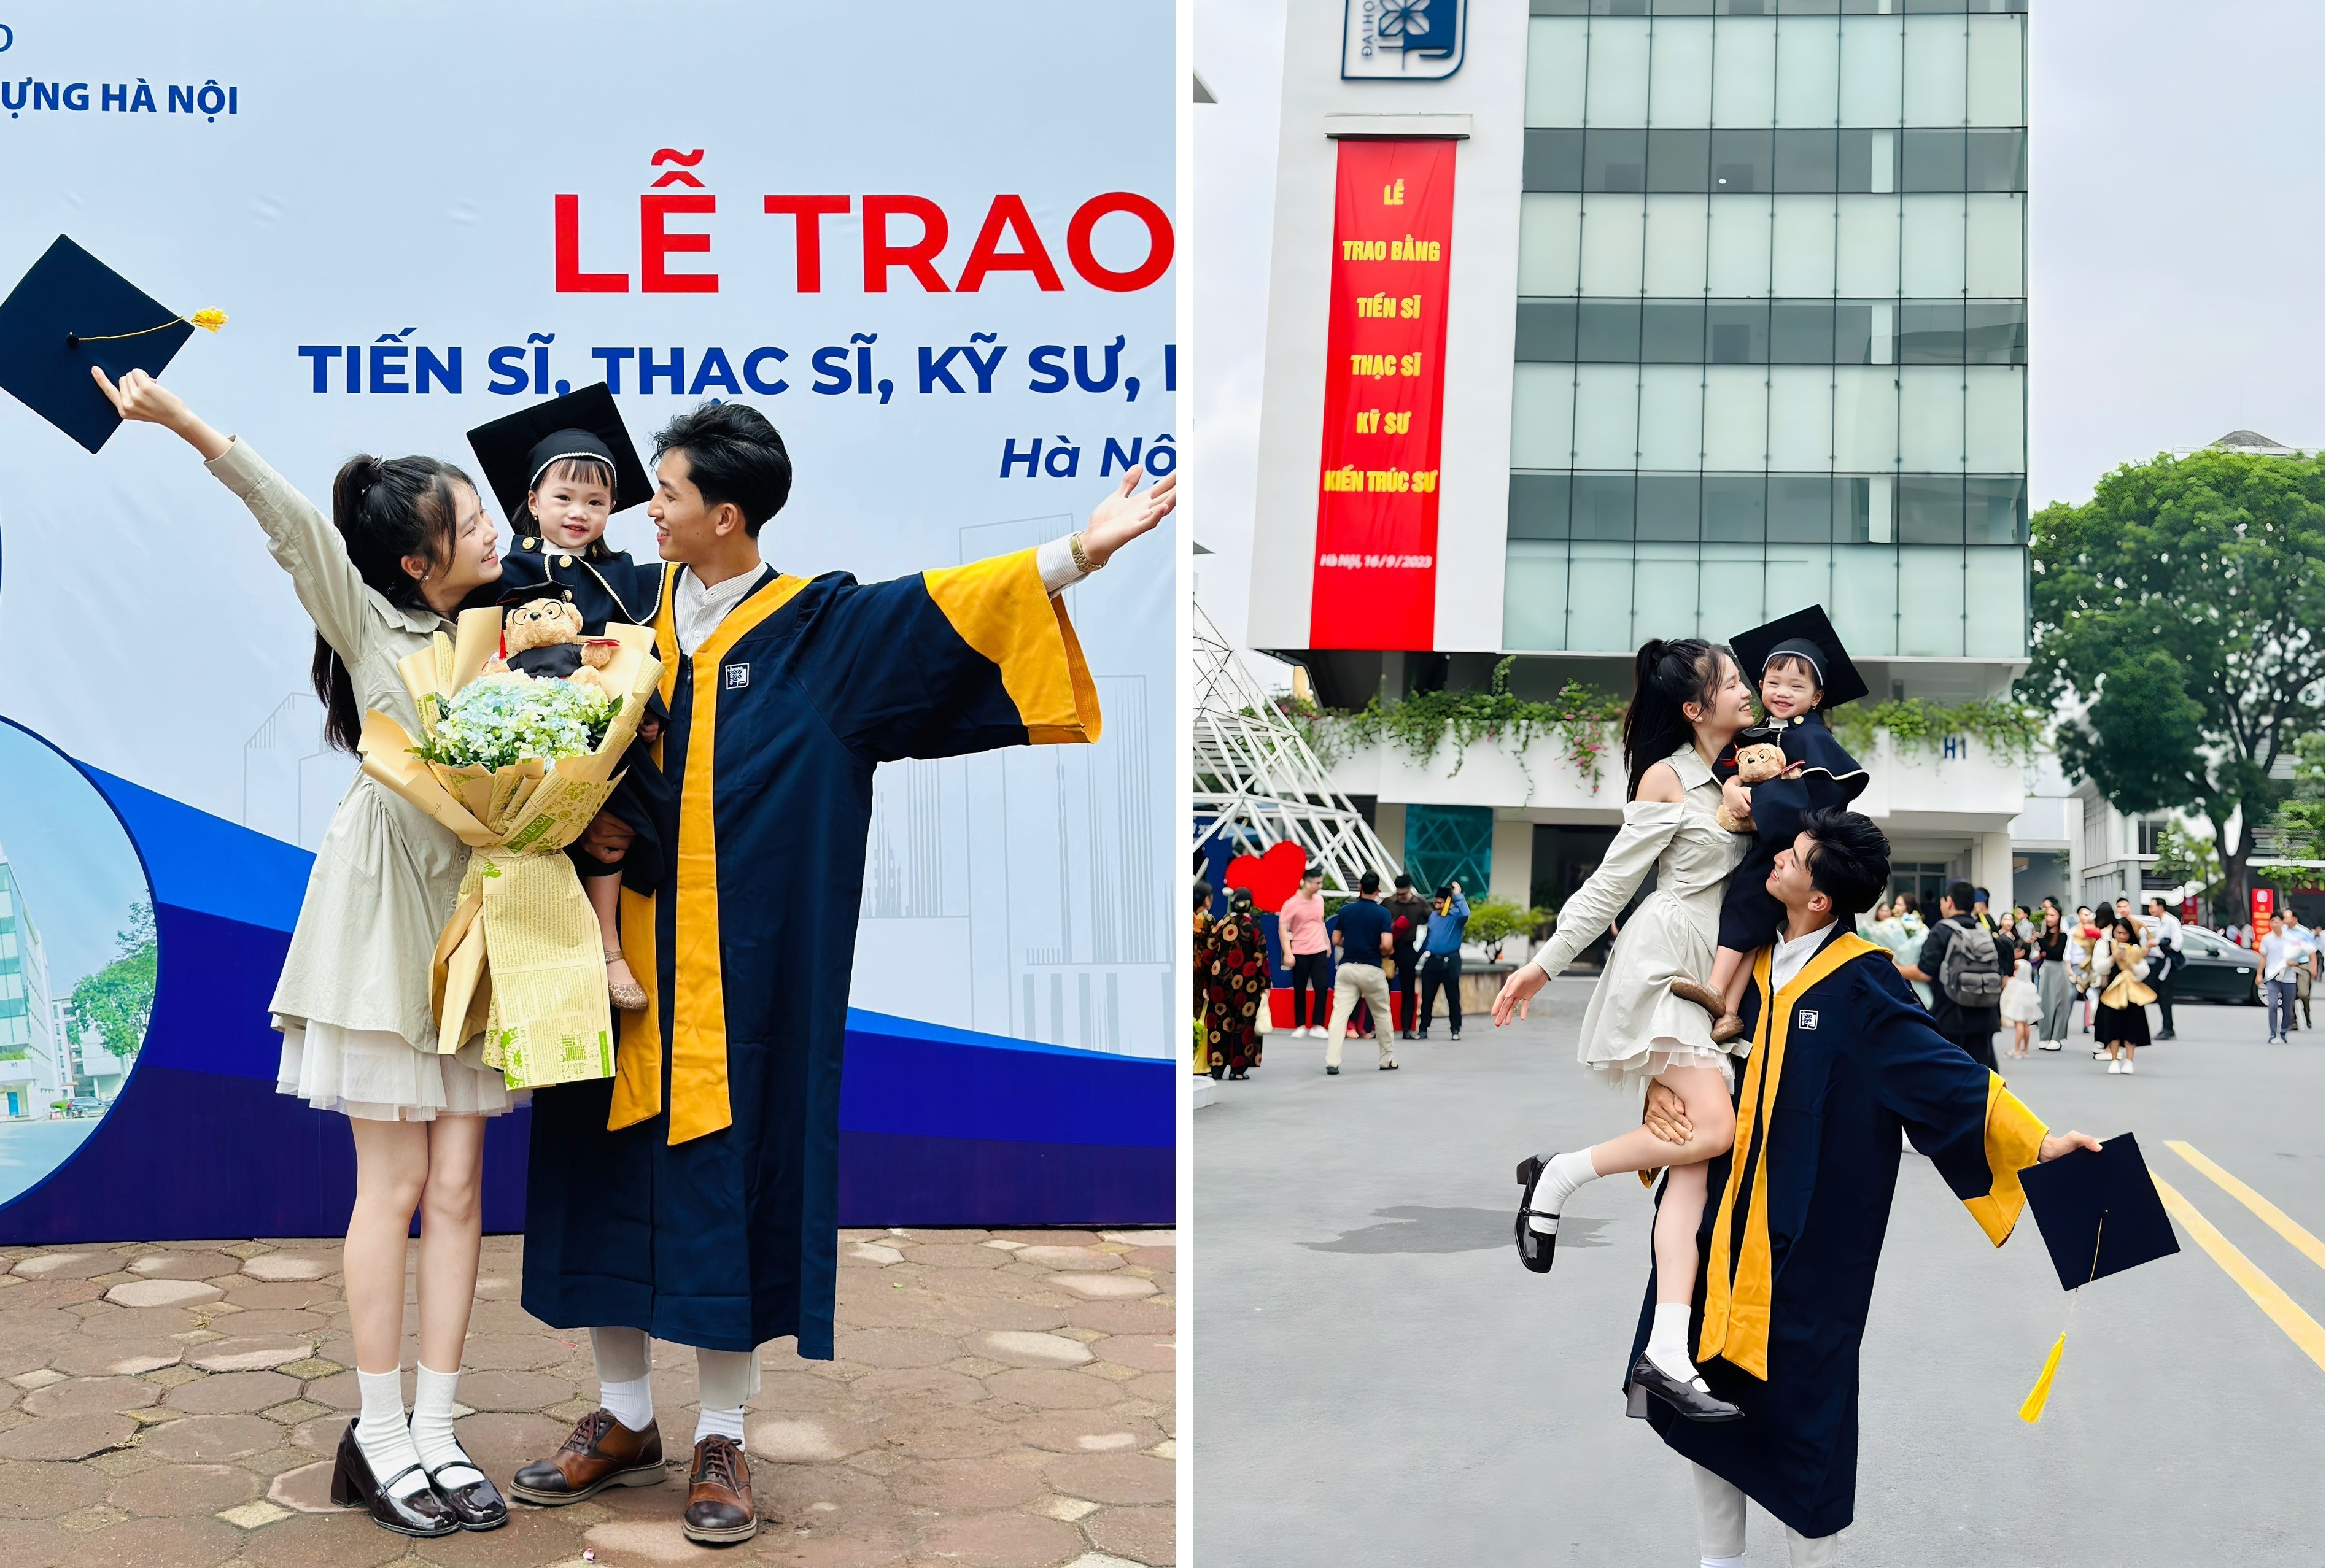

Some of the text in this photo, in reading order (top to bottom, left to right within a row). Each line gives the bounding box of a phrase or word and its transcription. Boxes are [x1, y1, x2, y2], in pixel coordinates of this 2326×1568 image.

[101, 77, 157, 113] HÀ
[168, 79, 238, 123] NỘI
[554, 147, 1175, 293] LỄ TRAO
[1342, 240, 1387, 261] TRAO
[1356, 291, 1422, 319] TIẾN SĨ
[298, 326, 462, 394] TIẾN
[487, 332, 571, 397] SĨ,
[591, 346, 790, 406] THẠC
[811, 332, 894, 404] SĨ,
[918, 331, 1008, 394] KỸ
[1028, 334, 1141, 403] SƯ,
[1350, 352, 1422, 380] THẠC SĨ
[1356, 408, 1412, 434] KỸ SƯ
[999, 434, 1081, 479] Hà
[1324, 463, 1438, 493] KIẾN TRÚC SƯ
[527, 815, 548, 832] YOUR
